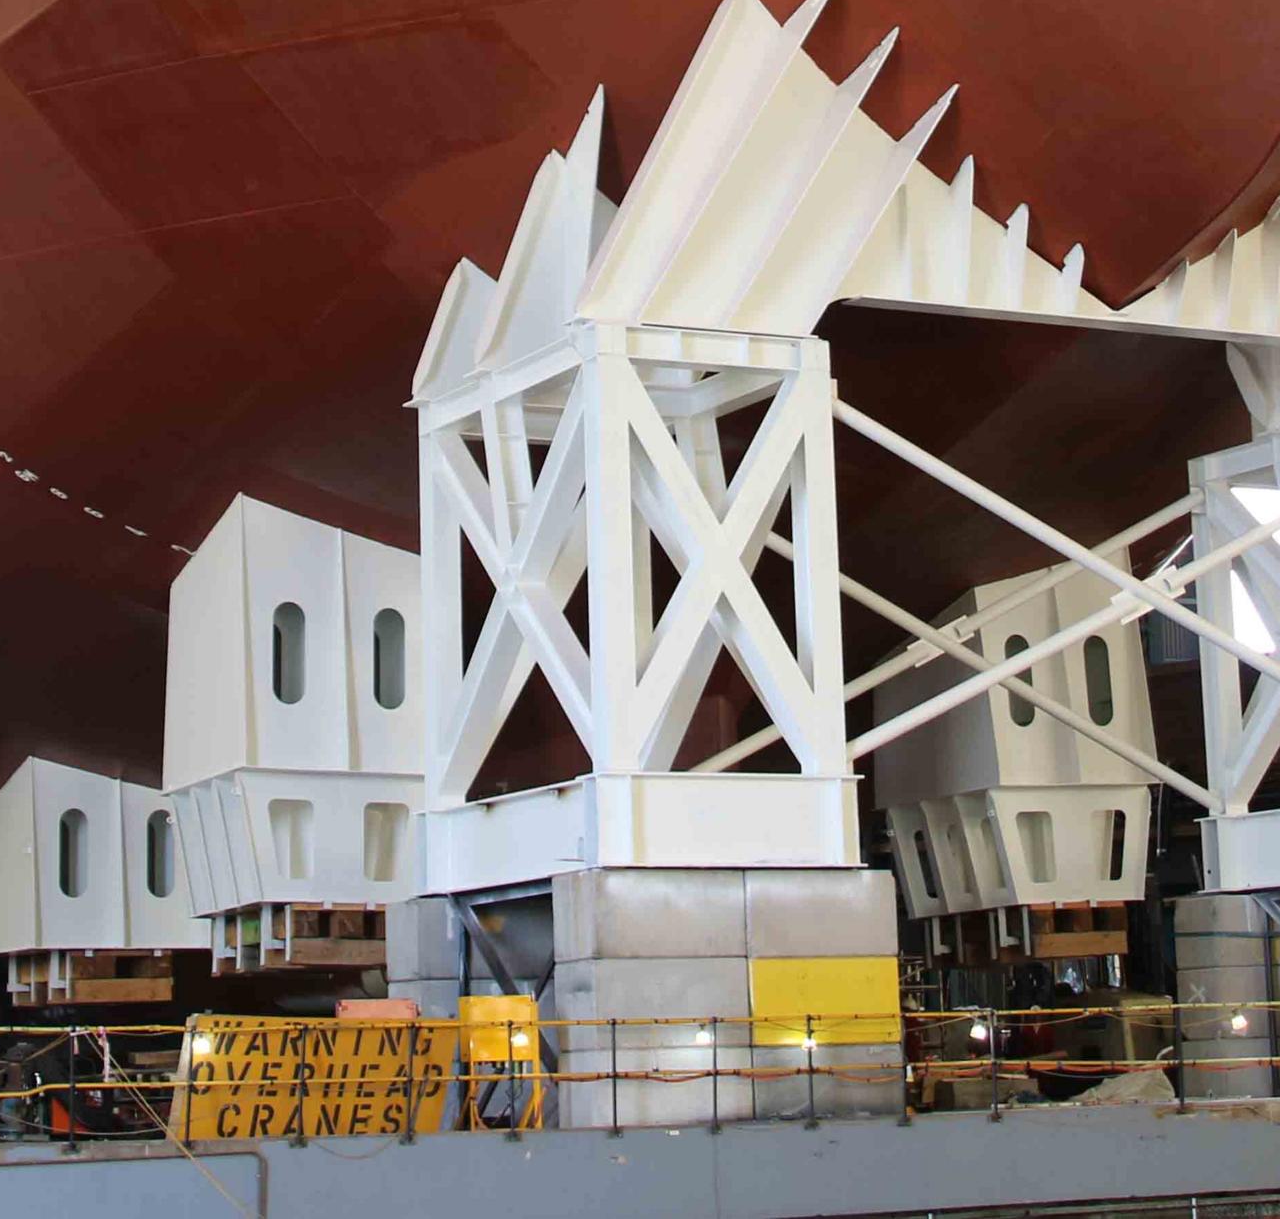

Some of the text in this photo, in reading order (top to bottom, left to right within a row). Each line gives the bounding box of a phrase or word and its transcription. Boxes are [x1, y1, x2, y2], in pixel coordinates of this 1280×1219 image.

[213, 1021, 436, 1057] WARNING
[188, 1061, 444, 1099] OVERHEAD
[216, 1104, 404, 1138] CRANES
